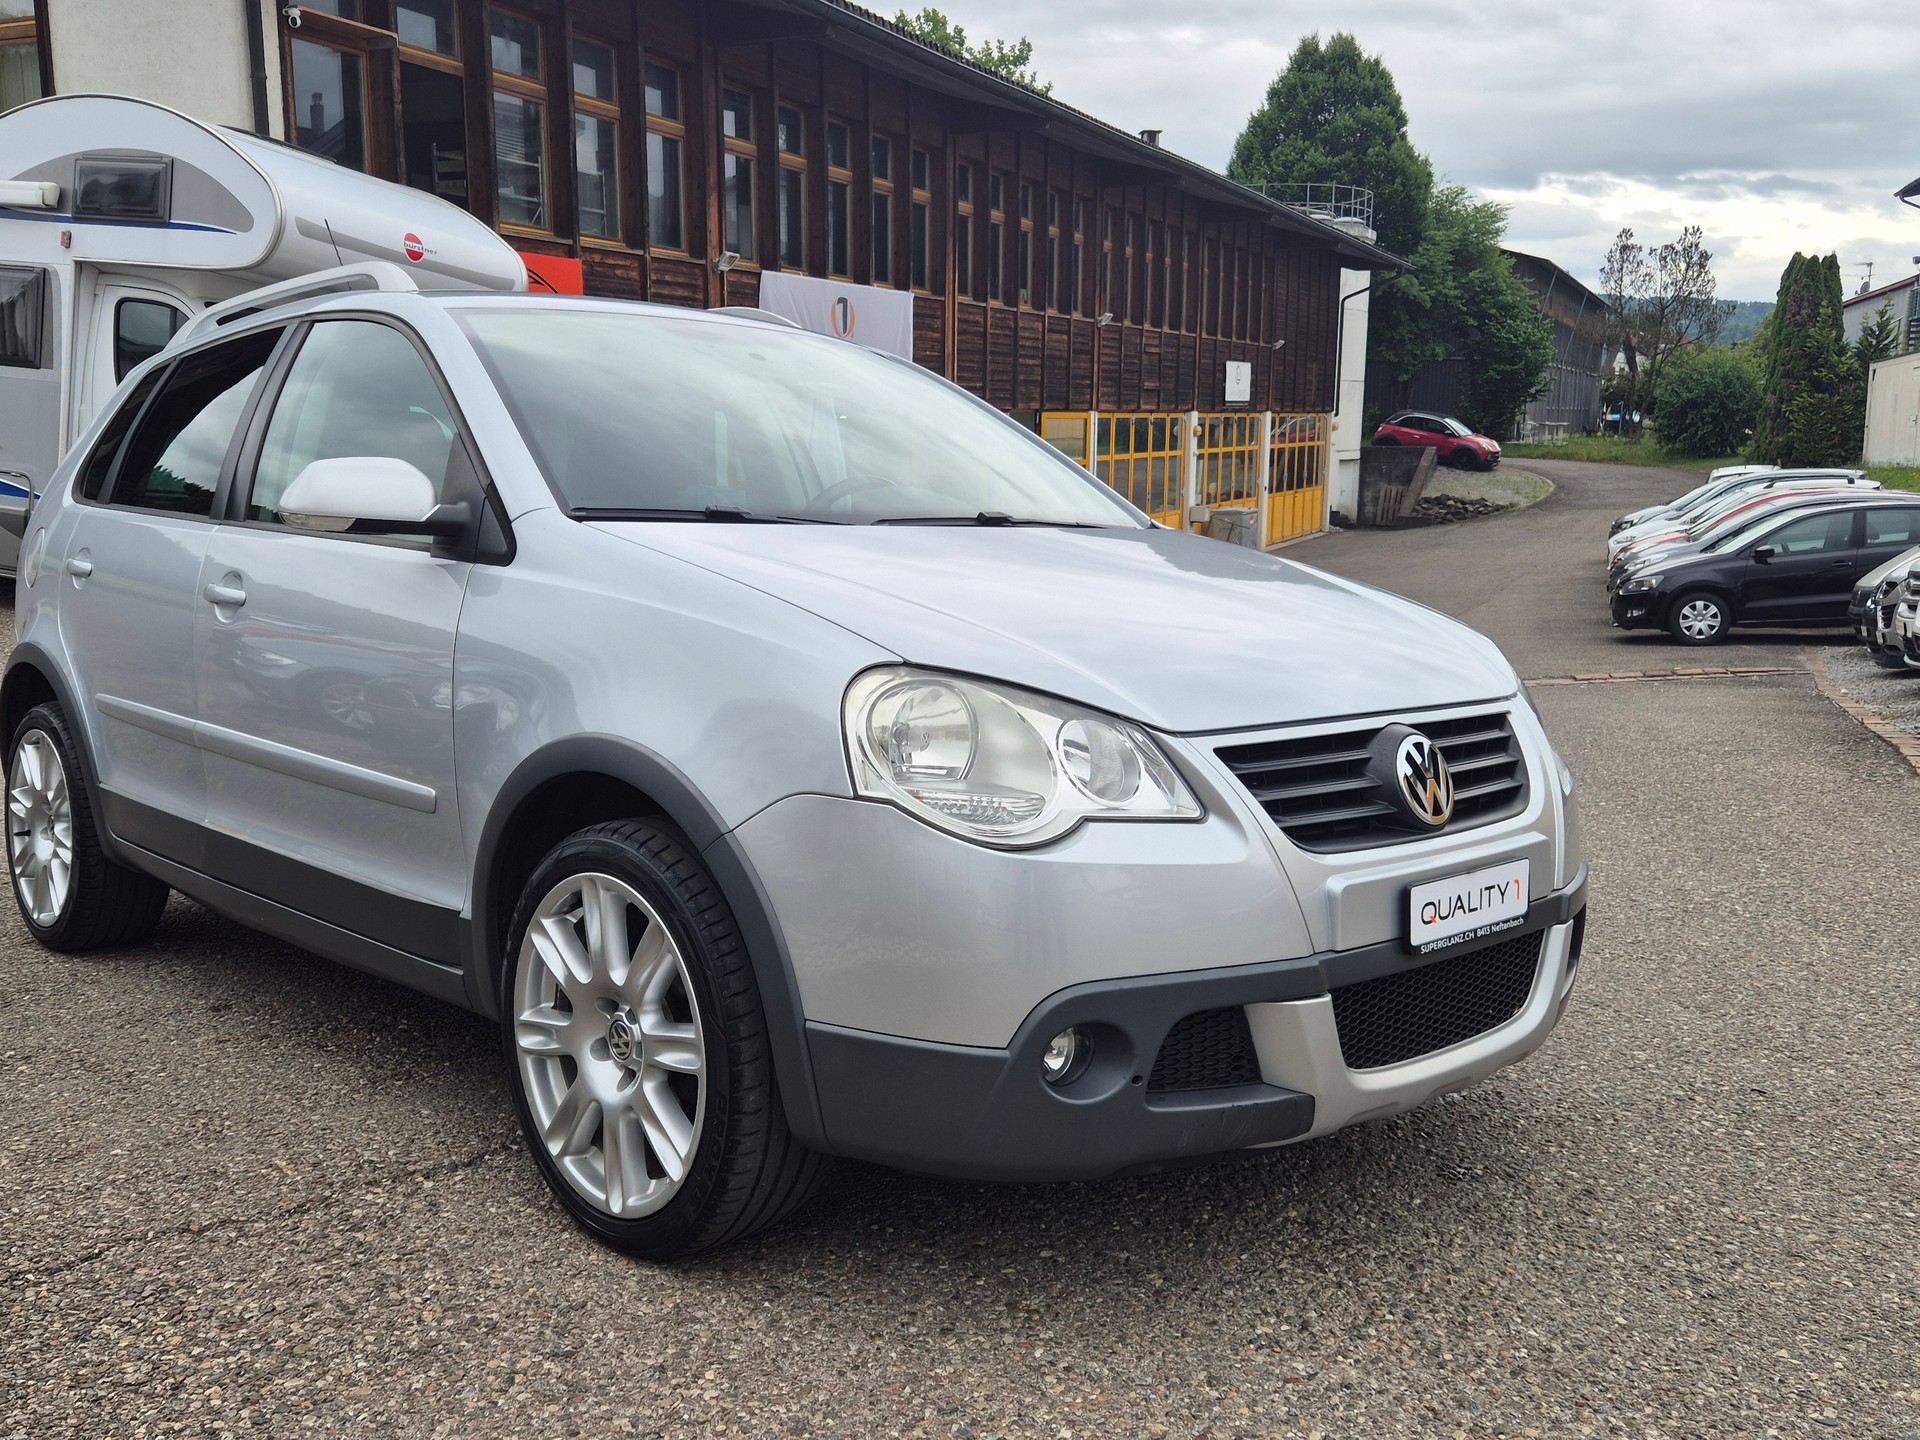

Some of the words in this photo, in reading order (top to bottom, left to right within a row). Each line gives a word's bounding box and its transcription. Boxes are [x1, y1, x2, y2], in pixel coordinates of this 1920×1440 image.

[403, 242, 437, 255] bürstner
[1421, 931, 1474, 954] SUPERGLANZ.CH
[1476, 926, 1490, 938] 8413
[1491, 918, 1523, 932] Neftenbach
